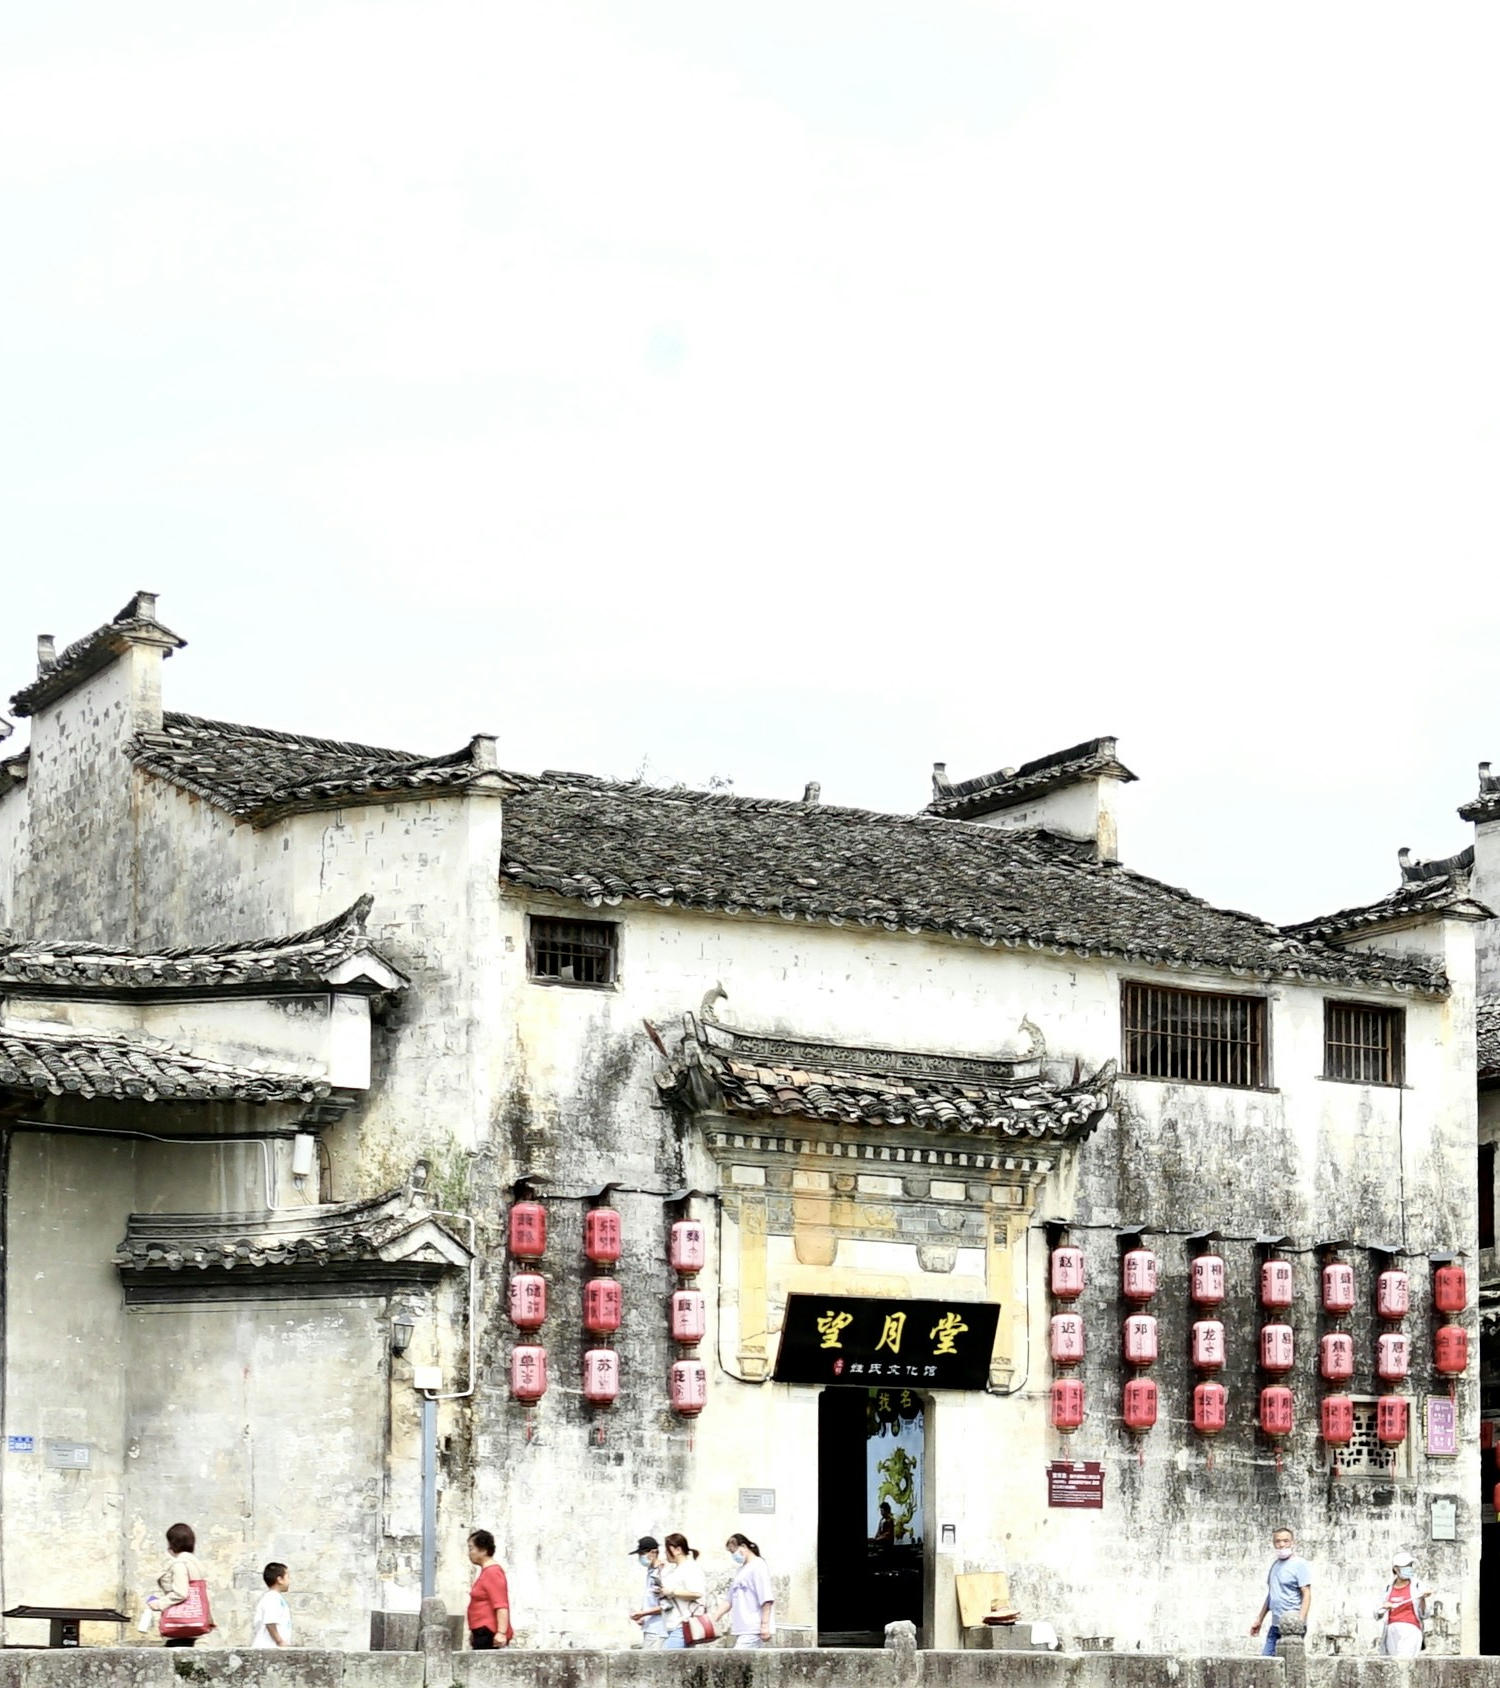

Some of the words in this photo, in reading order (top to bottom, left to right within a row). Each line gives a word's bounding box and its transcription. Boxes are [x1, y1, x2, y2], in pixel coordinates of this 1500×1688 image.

[816, 1310, 969, 1355] 望月堂
[1203, 1328, 1216, 1342] 龙
[597, 1358, 612, 1372] 苏
[849, 1362, 938, 1378] 姓氏文化馆
